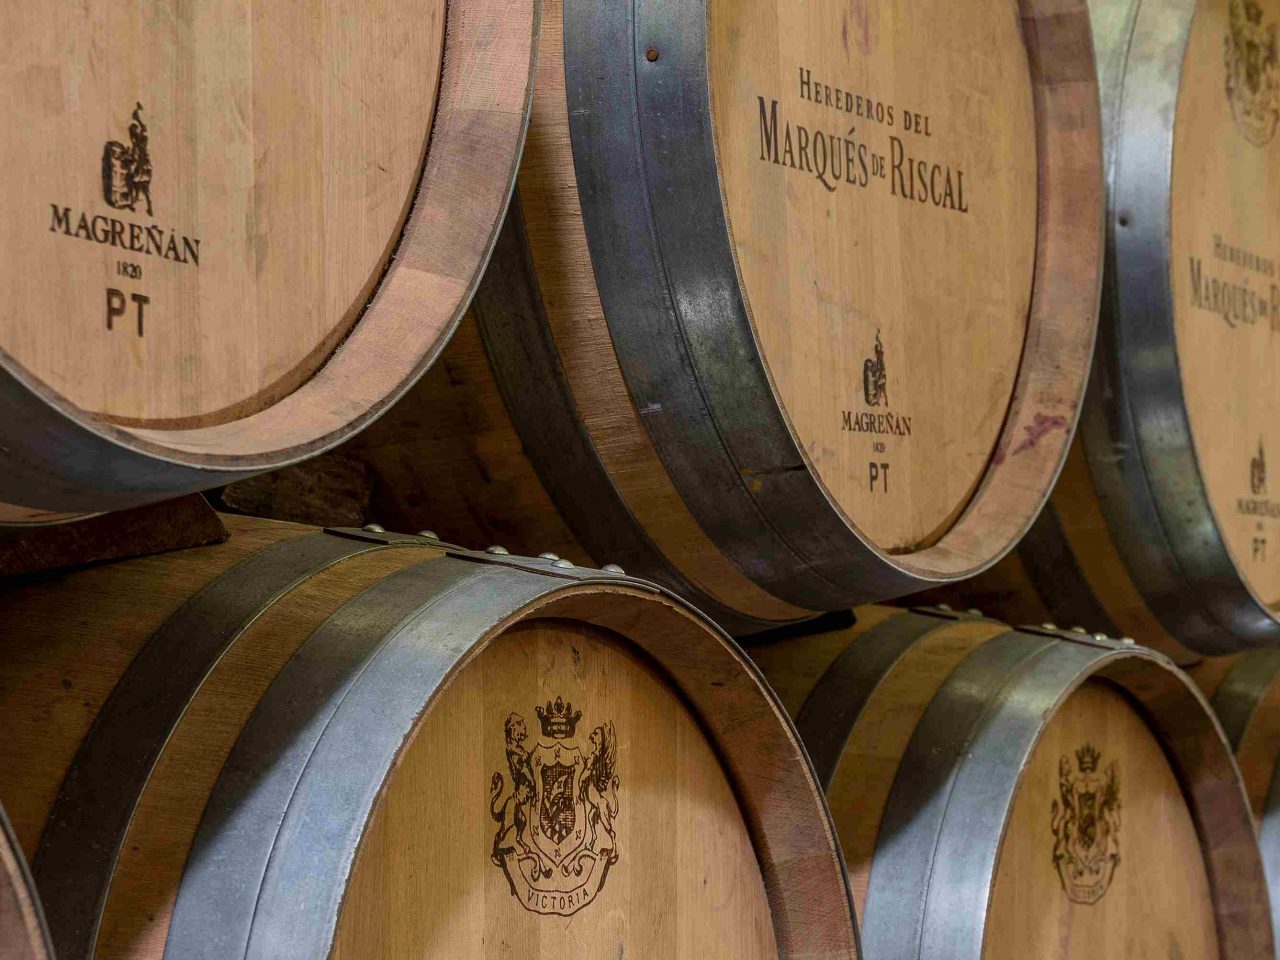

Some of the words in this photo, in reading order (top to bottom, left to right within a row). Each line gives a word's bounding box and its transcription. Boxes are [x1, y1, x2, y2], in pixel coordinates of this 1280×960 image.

[798, 67, 895, 127] HEREDEROS
[903, 110, 932, 137] DEL
[757, 96, 869, 192] MARQUÉS
[871, 153, 886, 179] DE
[889, 135, 968, 213] RISCAL
[116, 261, 142, 280] 1820
[106, 288, 150, 337] PT
[869, 461, 890, 493] PT
[527, 887, 590, 911] VICTORIA
